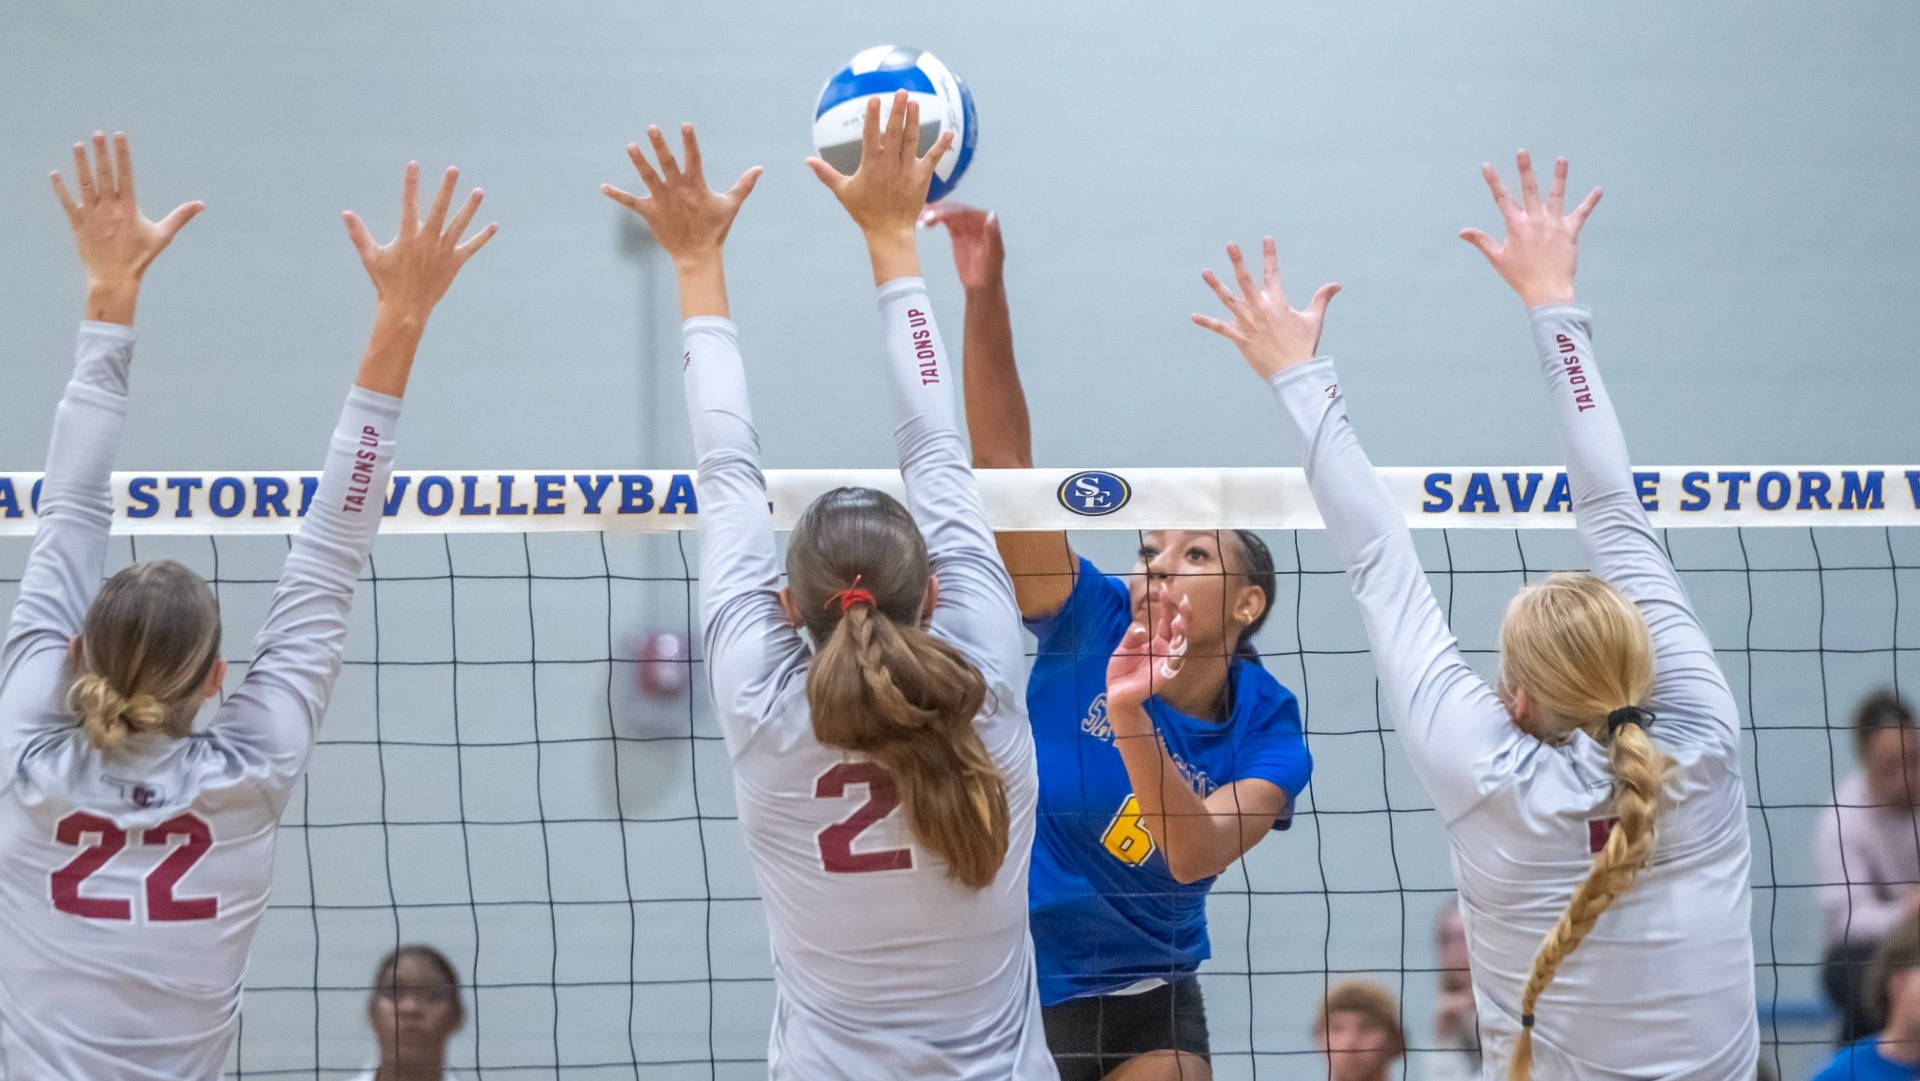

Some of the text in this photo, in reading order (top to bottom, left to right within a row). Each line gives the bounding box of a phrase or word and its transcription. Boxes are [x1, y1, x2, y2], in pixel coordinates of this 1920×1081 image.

[907, 308, 940, 386] TALONS UP
[1556, 333, 1596, 413] TALONS UP
[342, 425, 380, 513] TALONS UP
[381, 474, 773, 516] VOLLEYBA
[1421, 472, 1661, 514] SAVAE
[1680, 470, 1886, 512] STORM
[812, 760, 917, 874] 2
[1100, 792, 1156, 868] 6
[48, 809, 220, 926] 22
